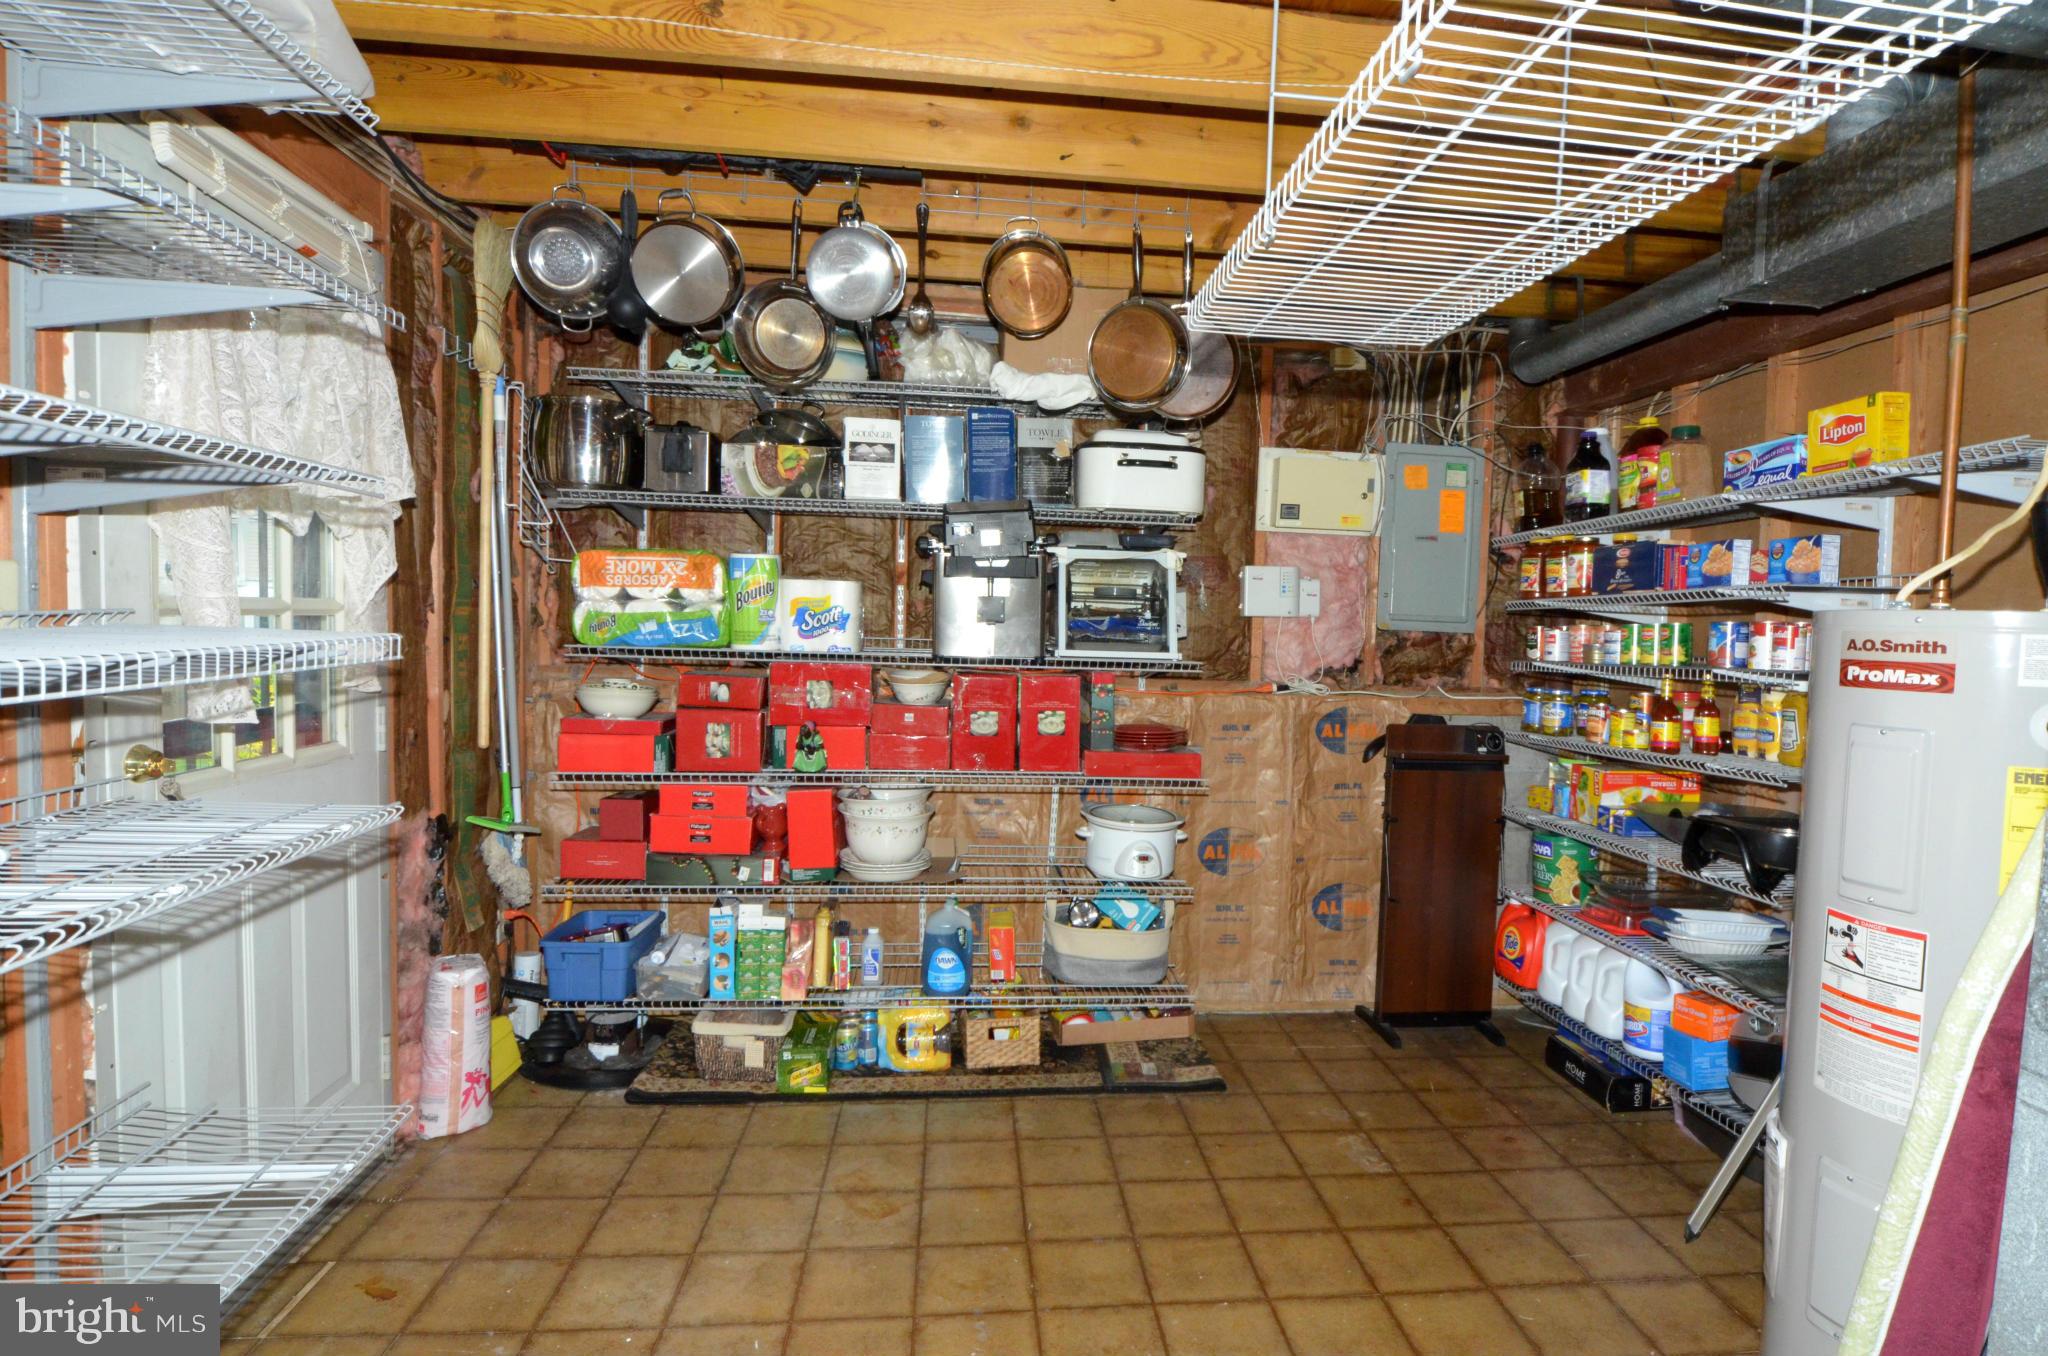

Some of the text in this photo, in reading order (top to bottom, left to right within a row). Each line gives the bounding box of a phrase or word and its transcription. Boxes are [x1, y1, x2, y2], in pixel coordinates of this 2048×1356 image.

[1028, 429, 1064, 437] TOWLE
[1823, 422, 1863, 441] Lipton
[1754, 464, 1793, 487] equal
[606, 559, 658, 574] MORE
[606, 575, 667, 585] ABSORBS
[735, 581, 775, 612] Bounty
[588, 615, 616, 633] Bounty
[801, 606, 843, 630] Scott
[1847, 665, 1940, 686] ProMax
[1861, 920, 1888, 932] DANGER
[1504, 934, 1519, 950] Tide
[936, 956, 958, 964] DAWN
[1565, 1061, 1586, 1082] HOME
[1633, 1083, 1641, 1107] HOME
